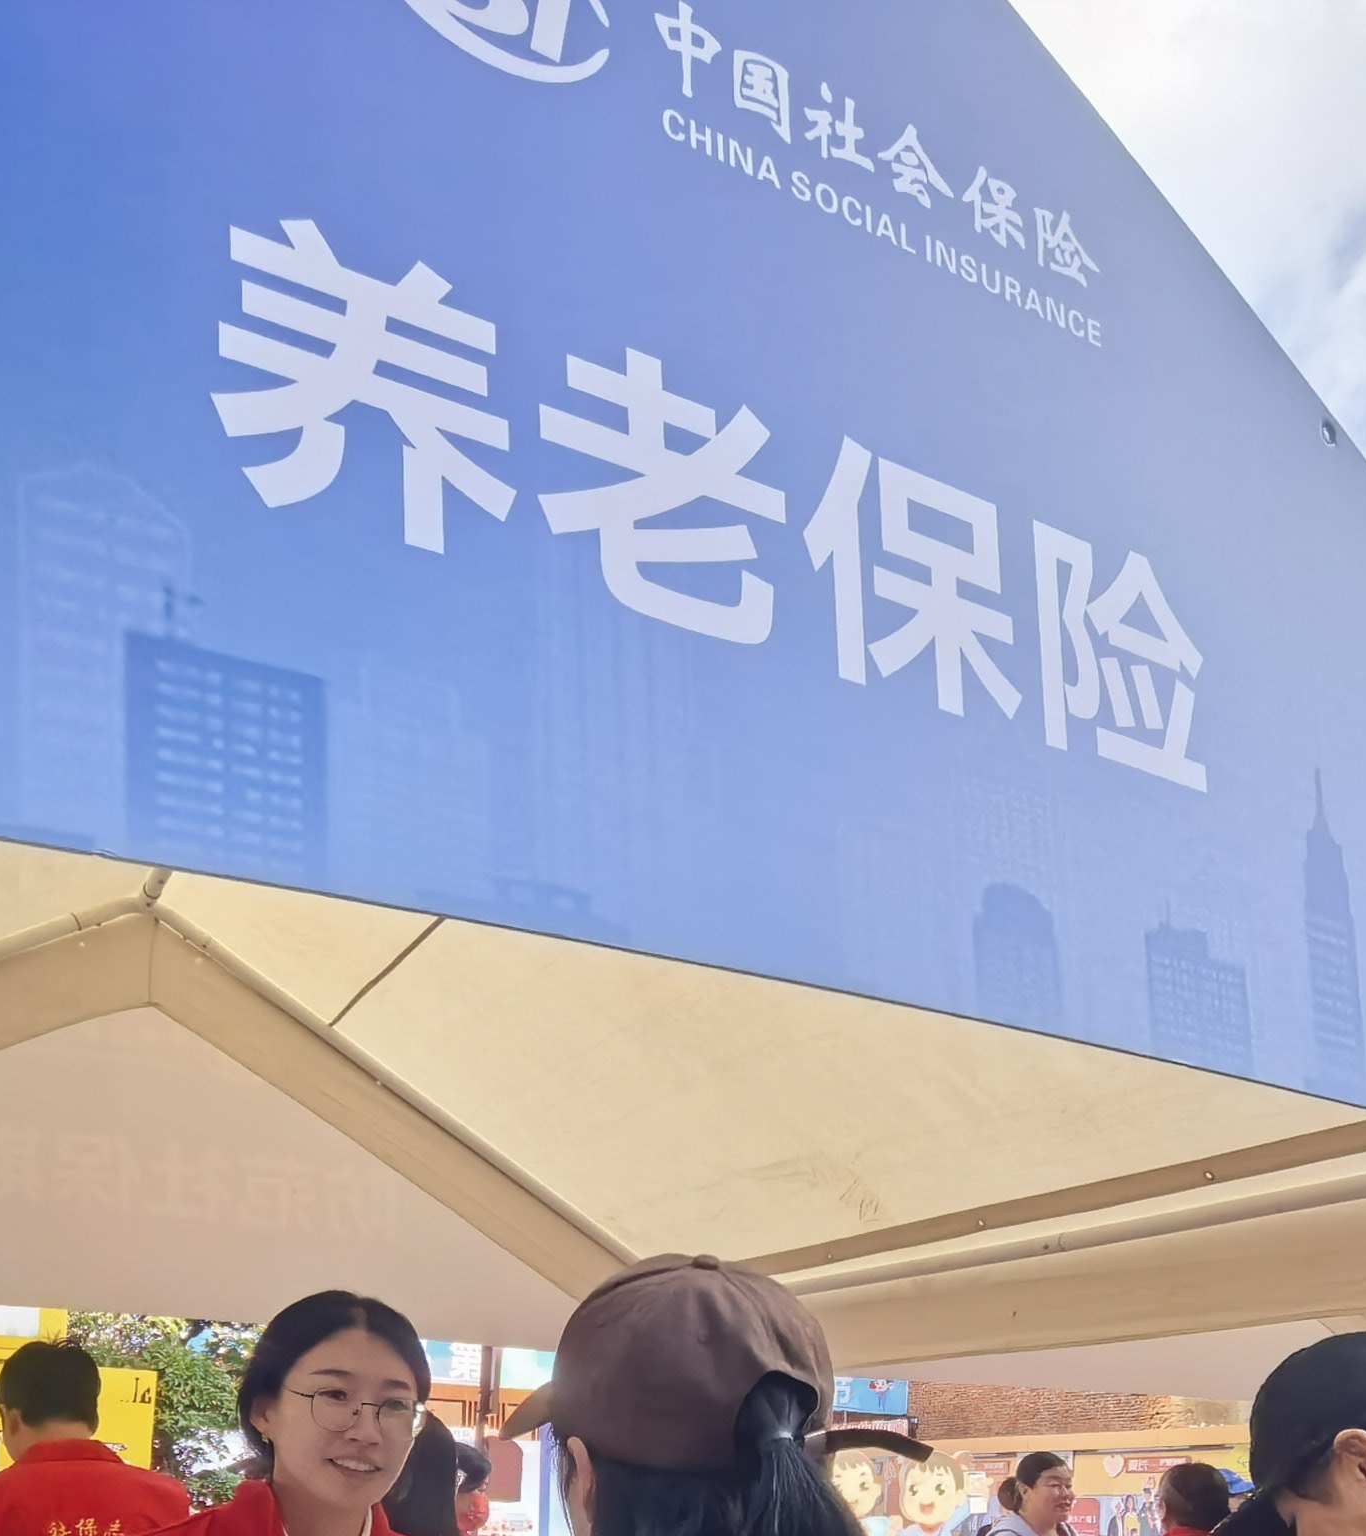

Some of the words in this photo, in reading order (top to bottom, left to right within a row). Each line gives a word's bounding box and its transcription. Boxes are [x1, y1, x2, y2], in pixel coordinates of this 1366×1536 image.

[654, 0, 1100, 288] 中国社会保险
[662, 108, 781, 191] CHINA
[790, 171, 917, 256] SOCIAL
[924, 234, 1102, 348] INSURANCE
[210, 218, 1207, 794] 养老保险
